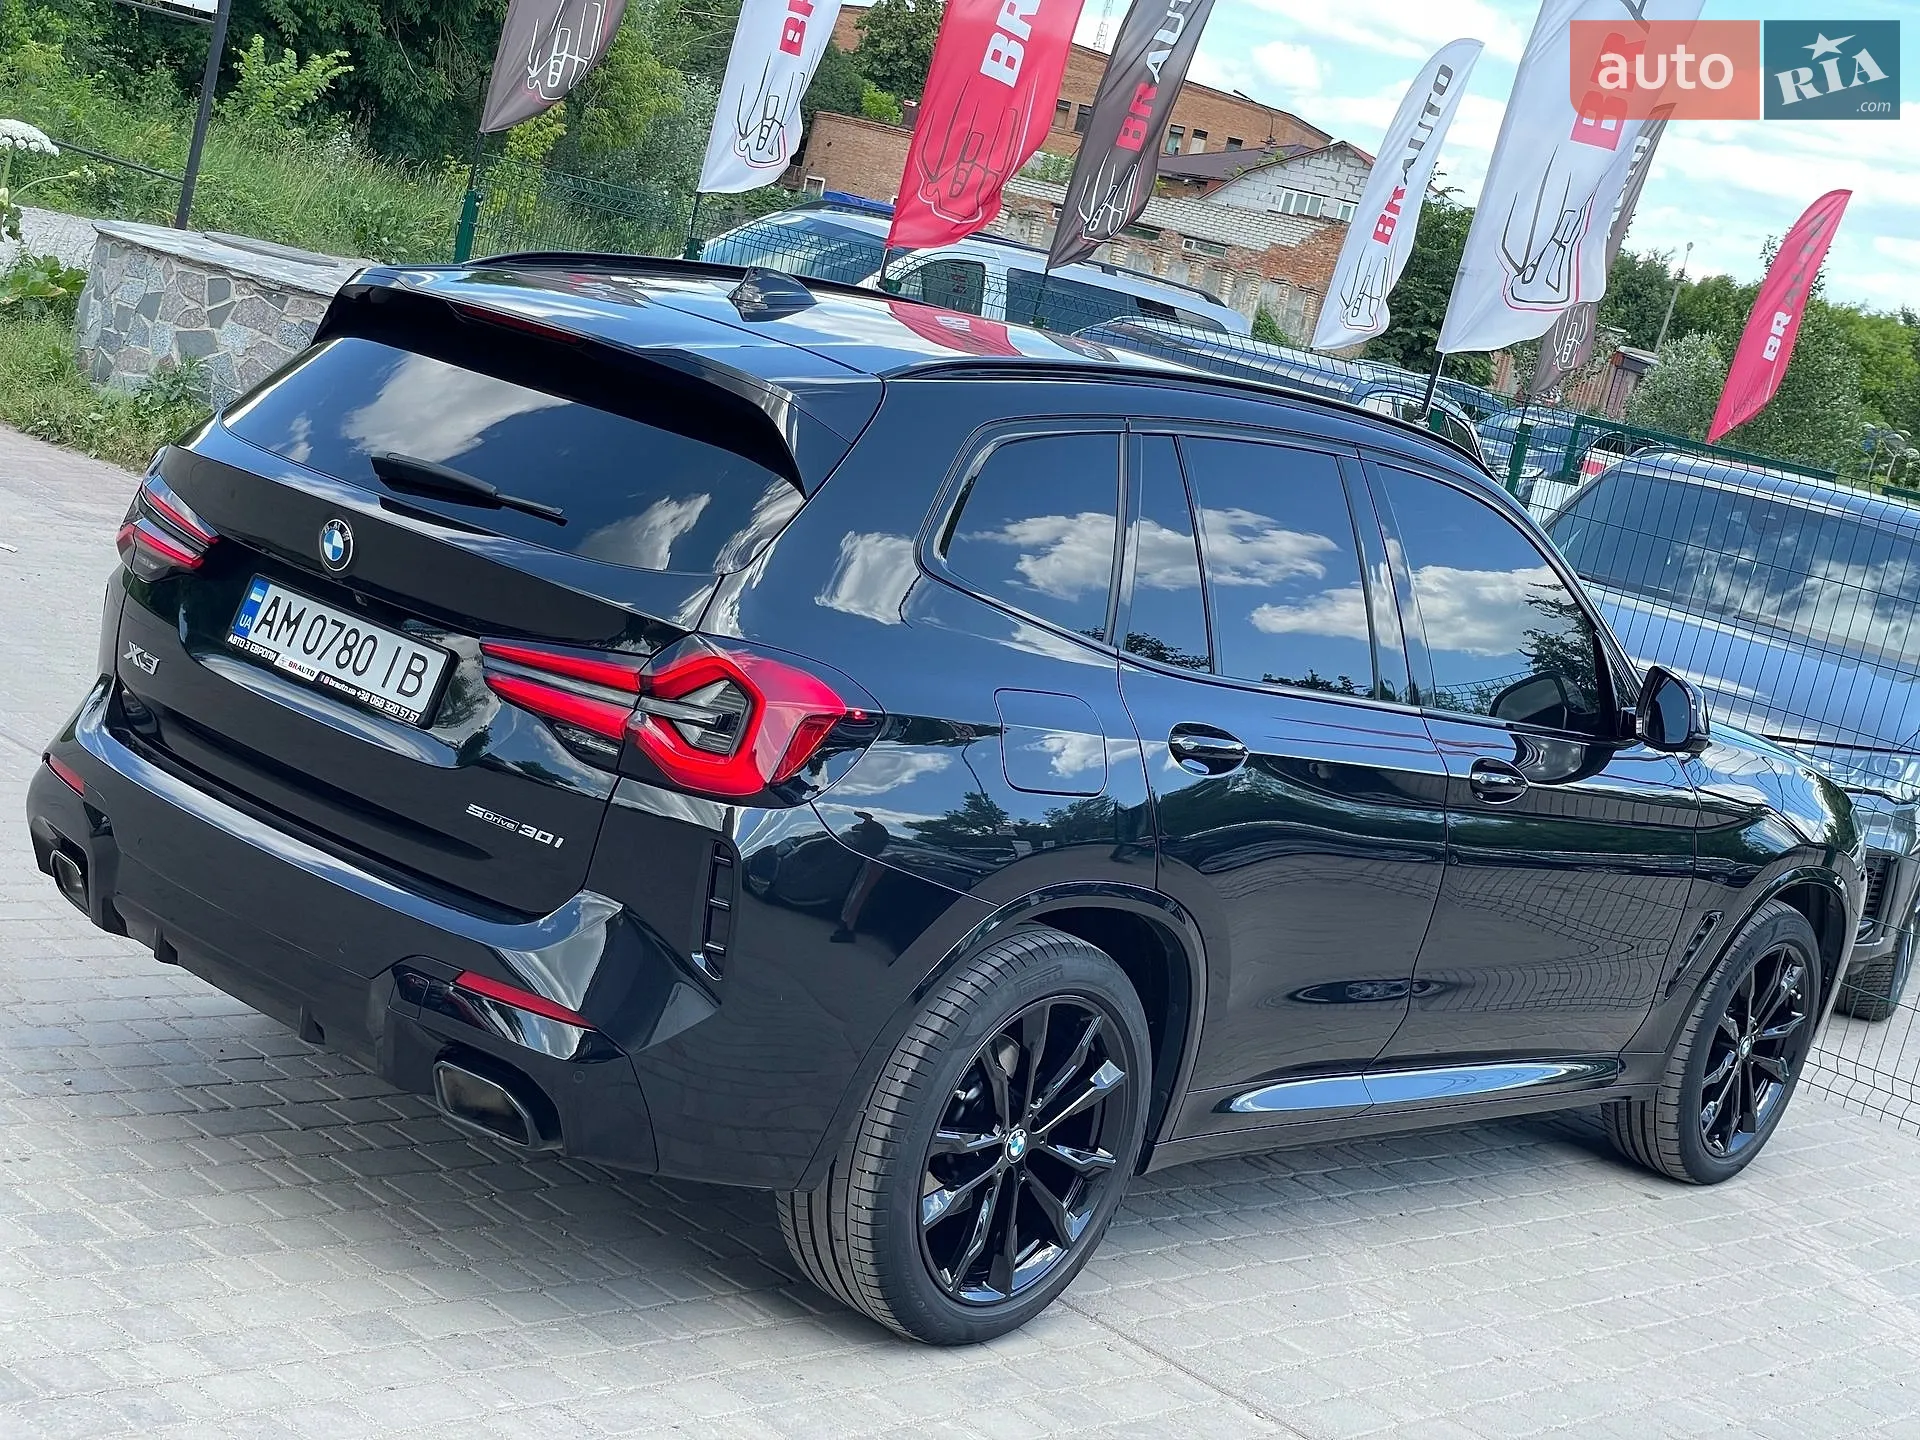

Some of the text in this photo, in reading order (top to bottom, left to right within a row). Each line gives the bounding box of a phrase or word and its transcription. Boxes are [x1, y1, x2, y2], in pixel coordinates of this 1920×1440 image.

[239, 613, 252, 633] UA
[123, 641, 160, 675] X3
[254, 595, 428, 697] AM 0780 IB
[288, 660, 316, 677] BRAUTO
